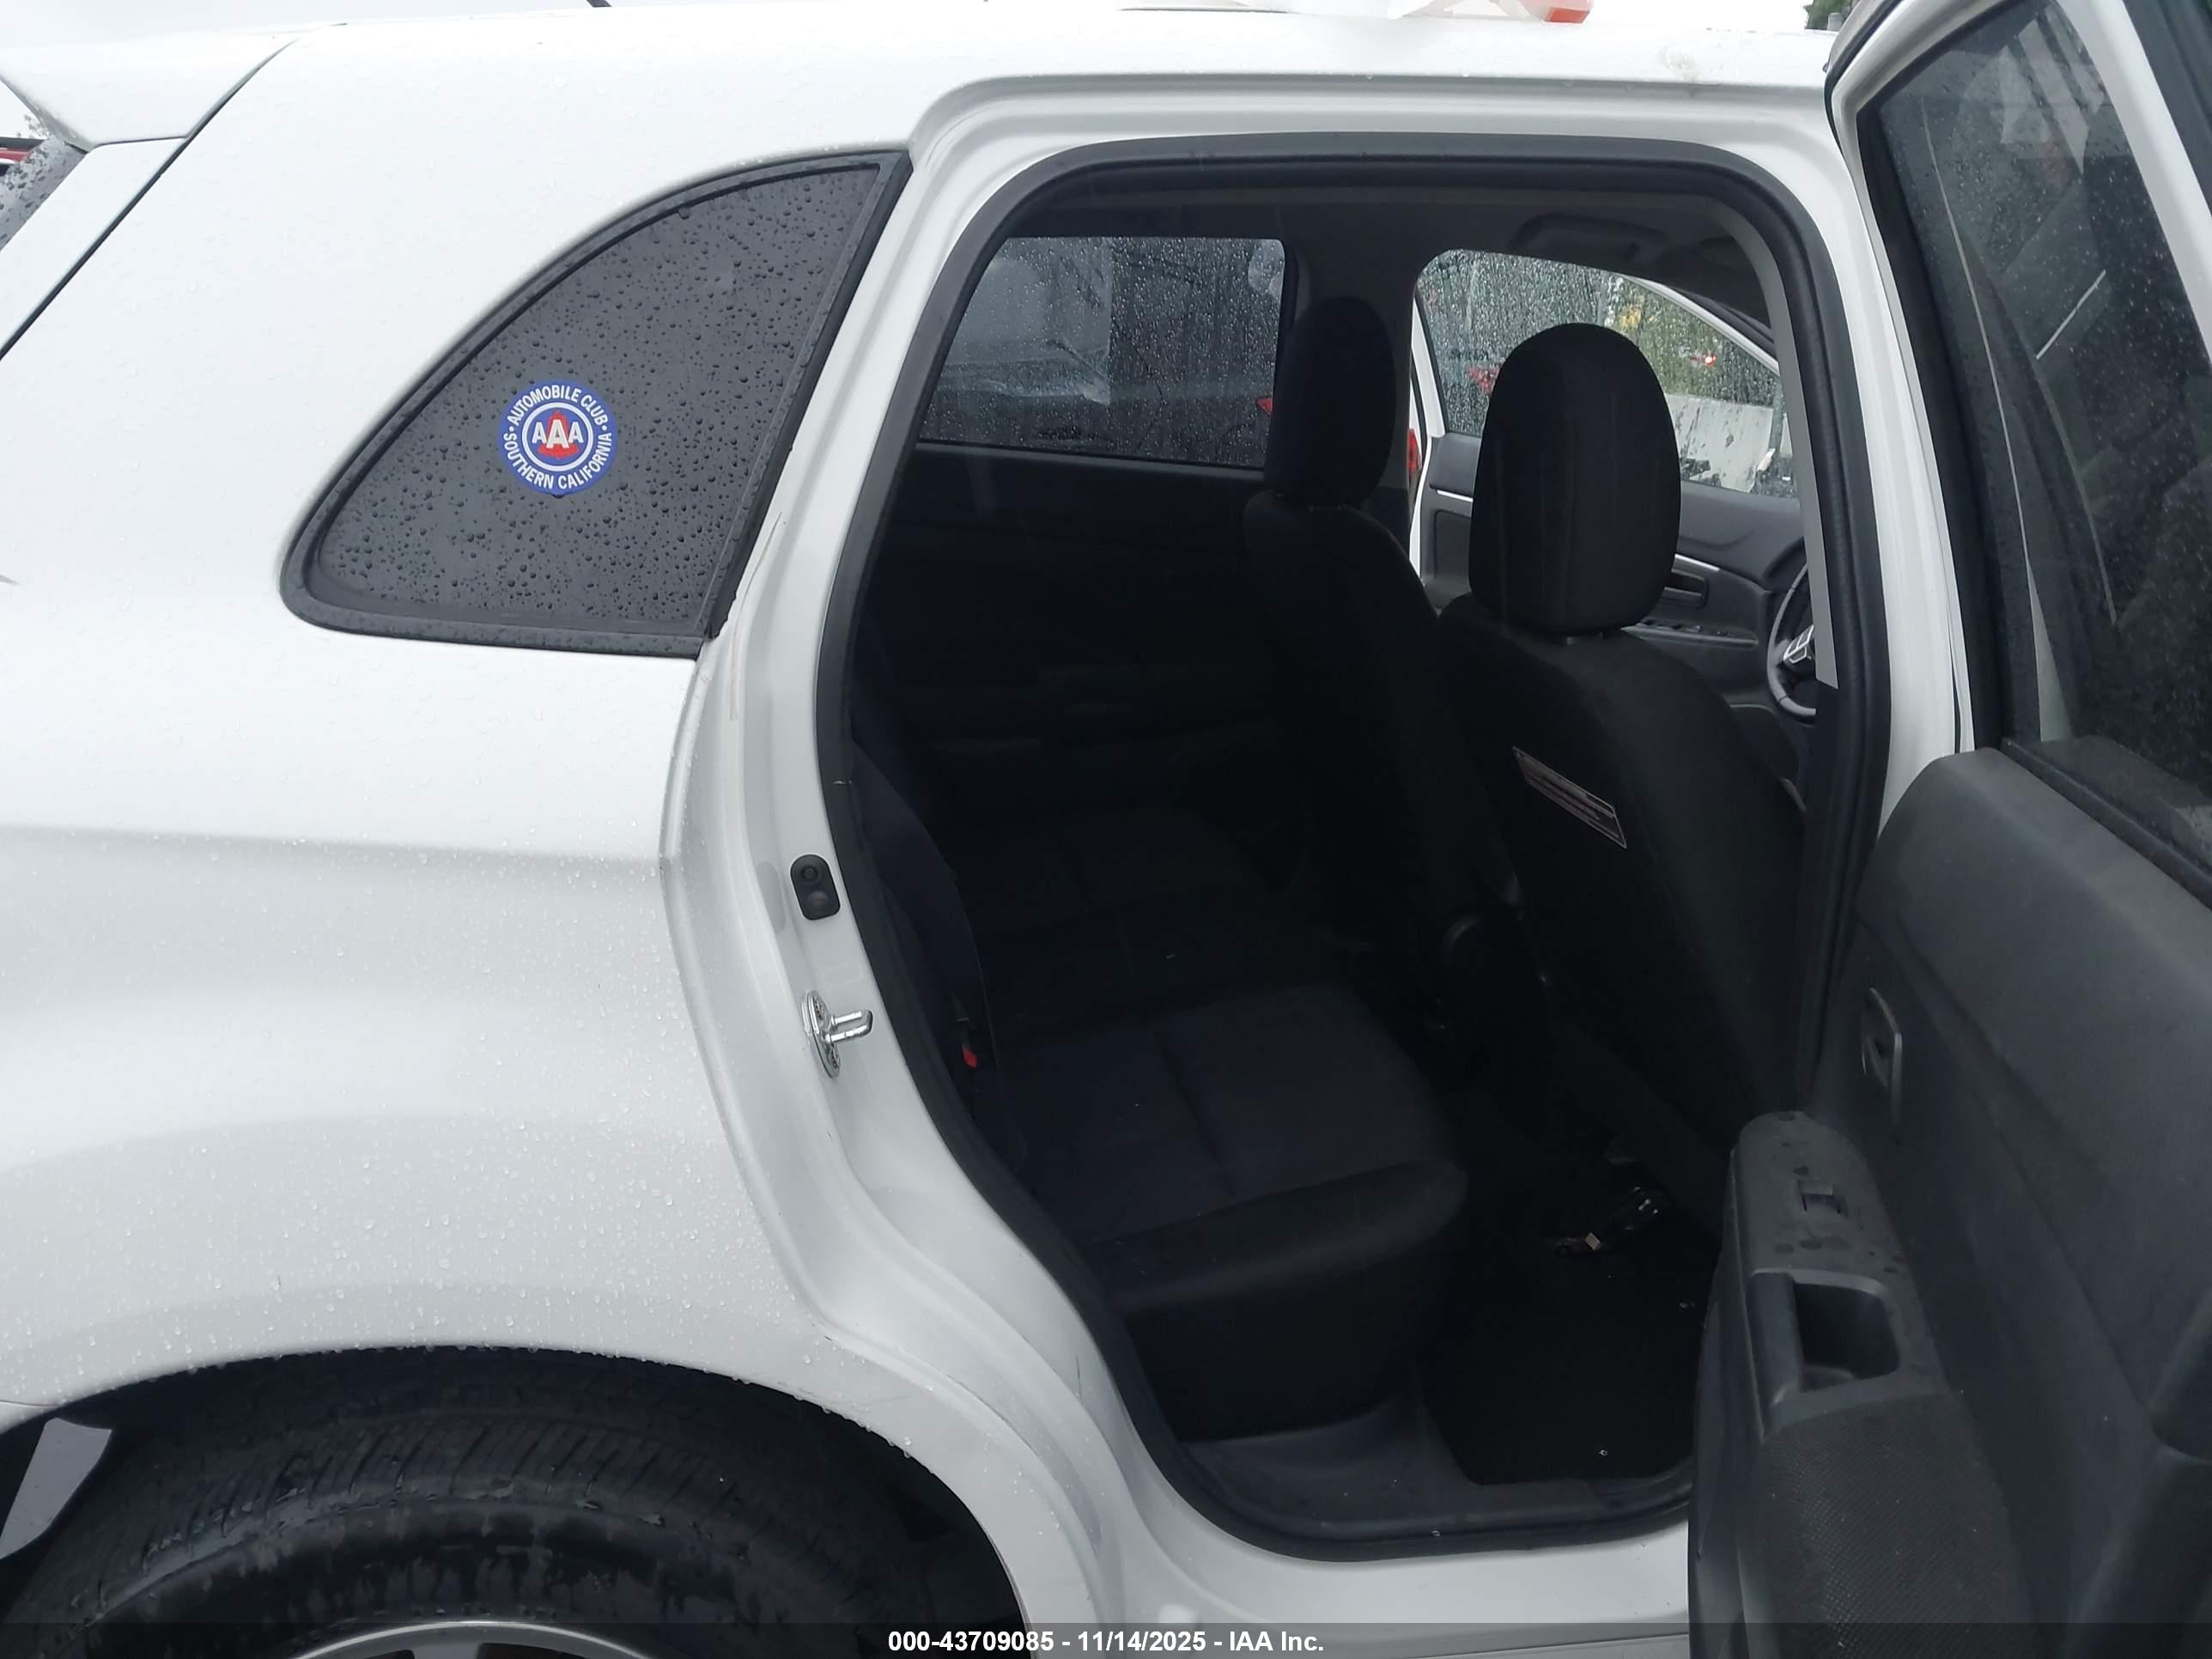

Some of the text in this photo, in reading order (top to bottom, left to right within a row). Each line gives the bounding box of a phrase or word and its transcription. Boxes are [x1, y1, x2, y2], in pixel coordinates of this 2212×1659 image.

[507, 384, 608, 426] AUTOMOBILE CLUB
[532, 419, 584, 449] AAA
[503, 432, 612, 489] SOUTHERN CALIFORNIA
